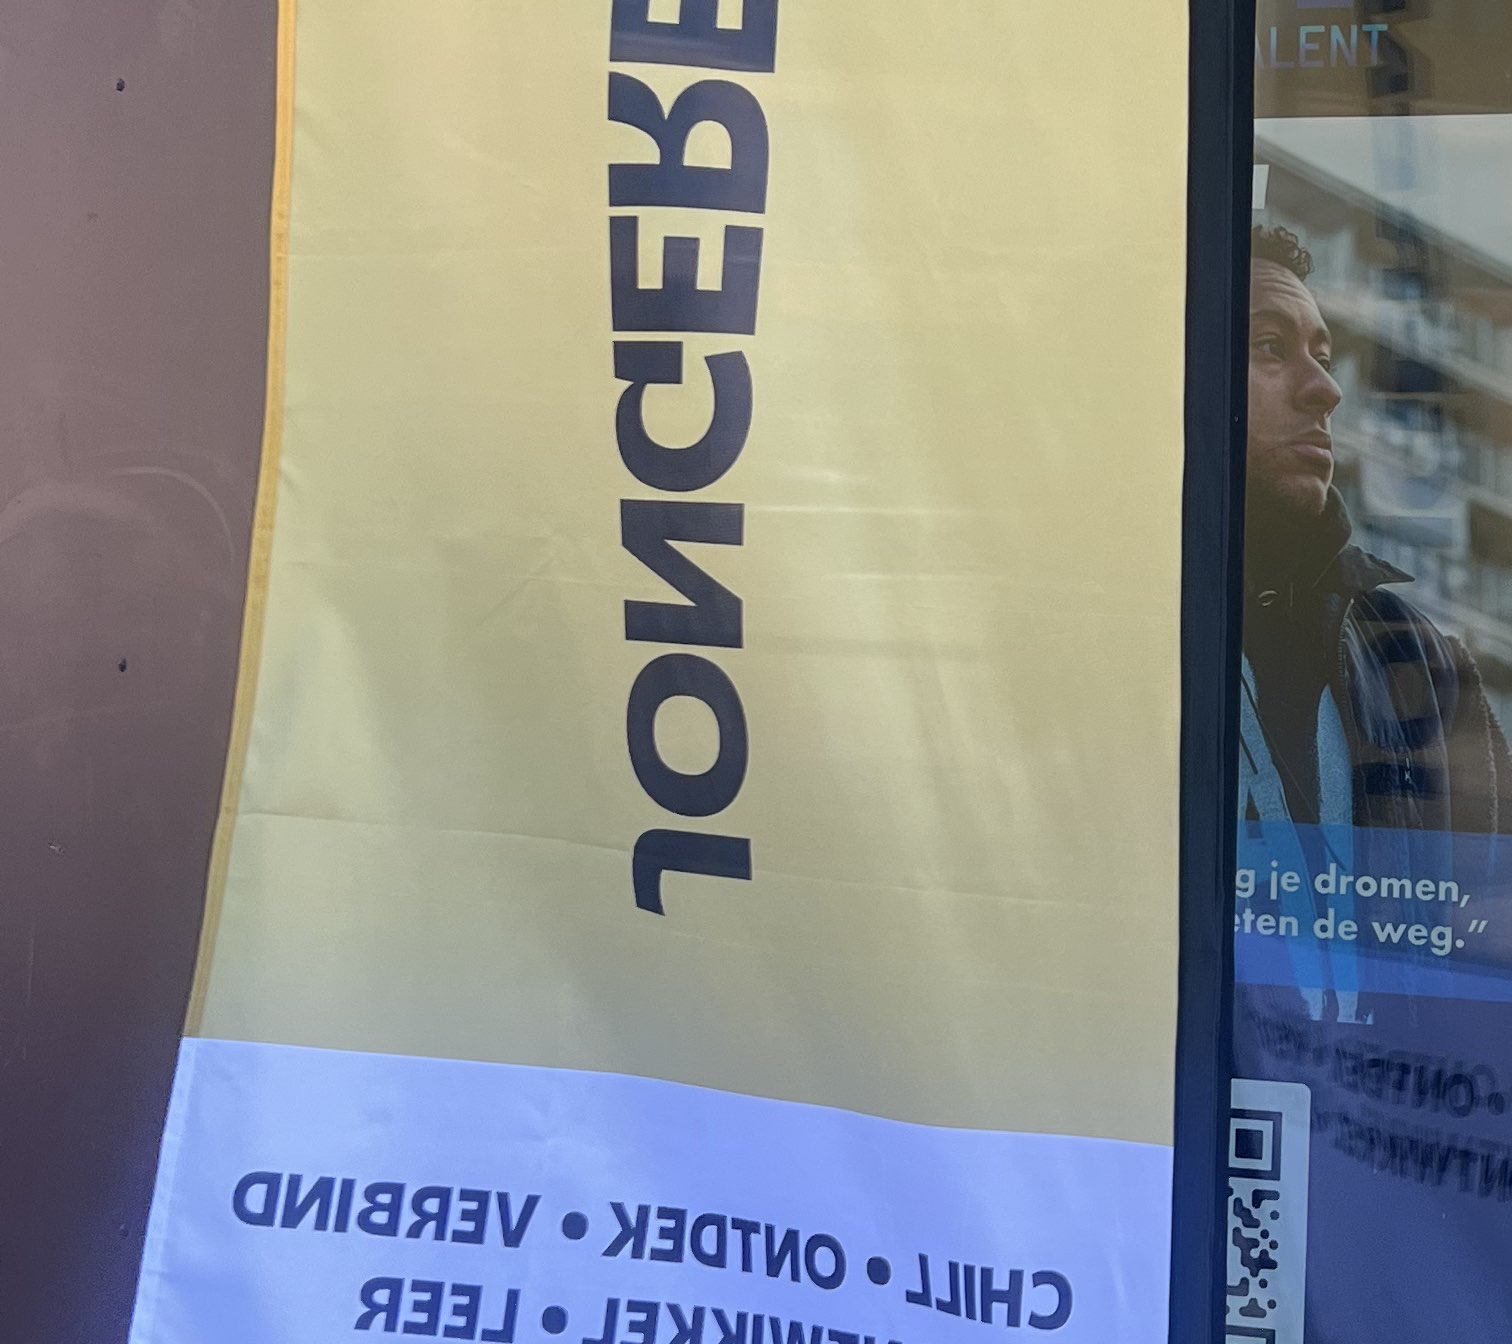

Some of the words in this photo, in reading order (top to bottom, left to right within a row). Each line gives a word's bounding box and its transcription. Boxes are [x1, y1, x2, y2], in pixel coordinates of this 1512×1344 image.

[1269, 859, 1301, 900] je
[1313, 862, 1471, 908] dromen,
[1312, 907, 1359, 941] de
